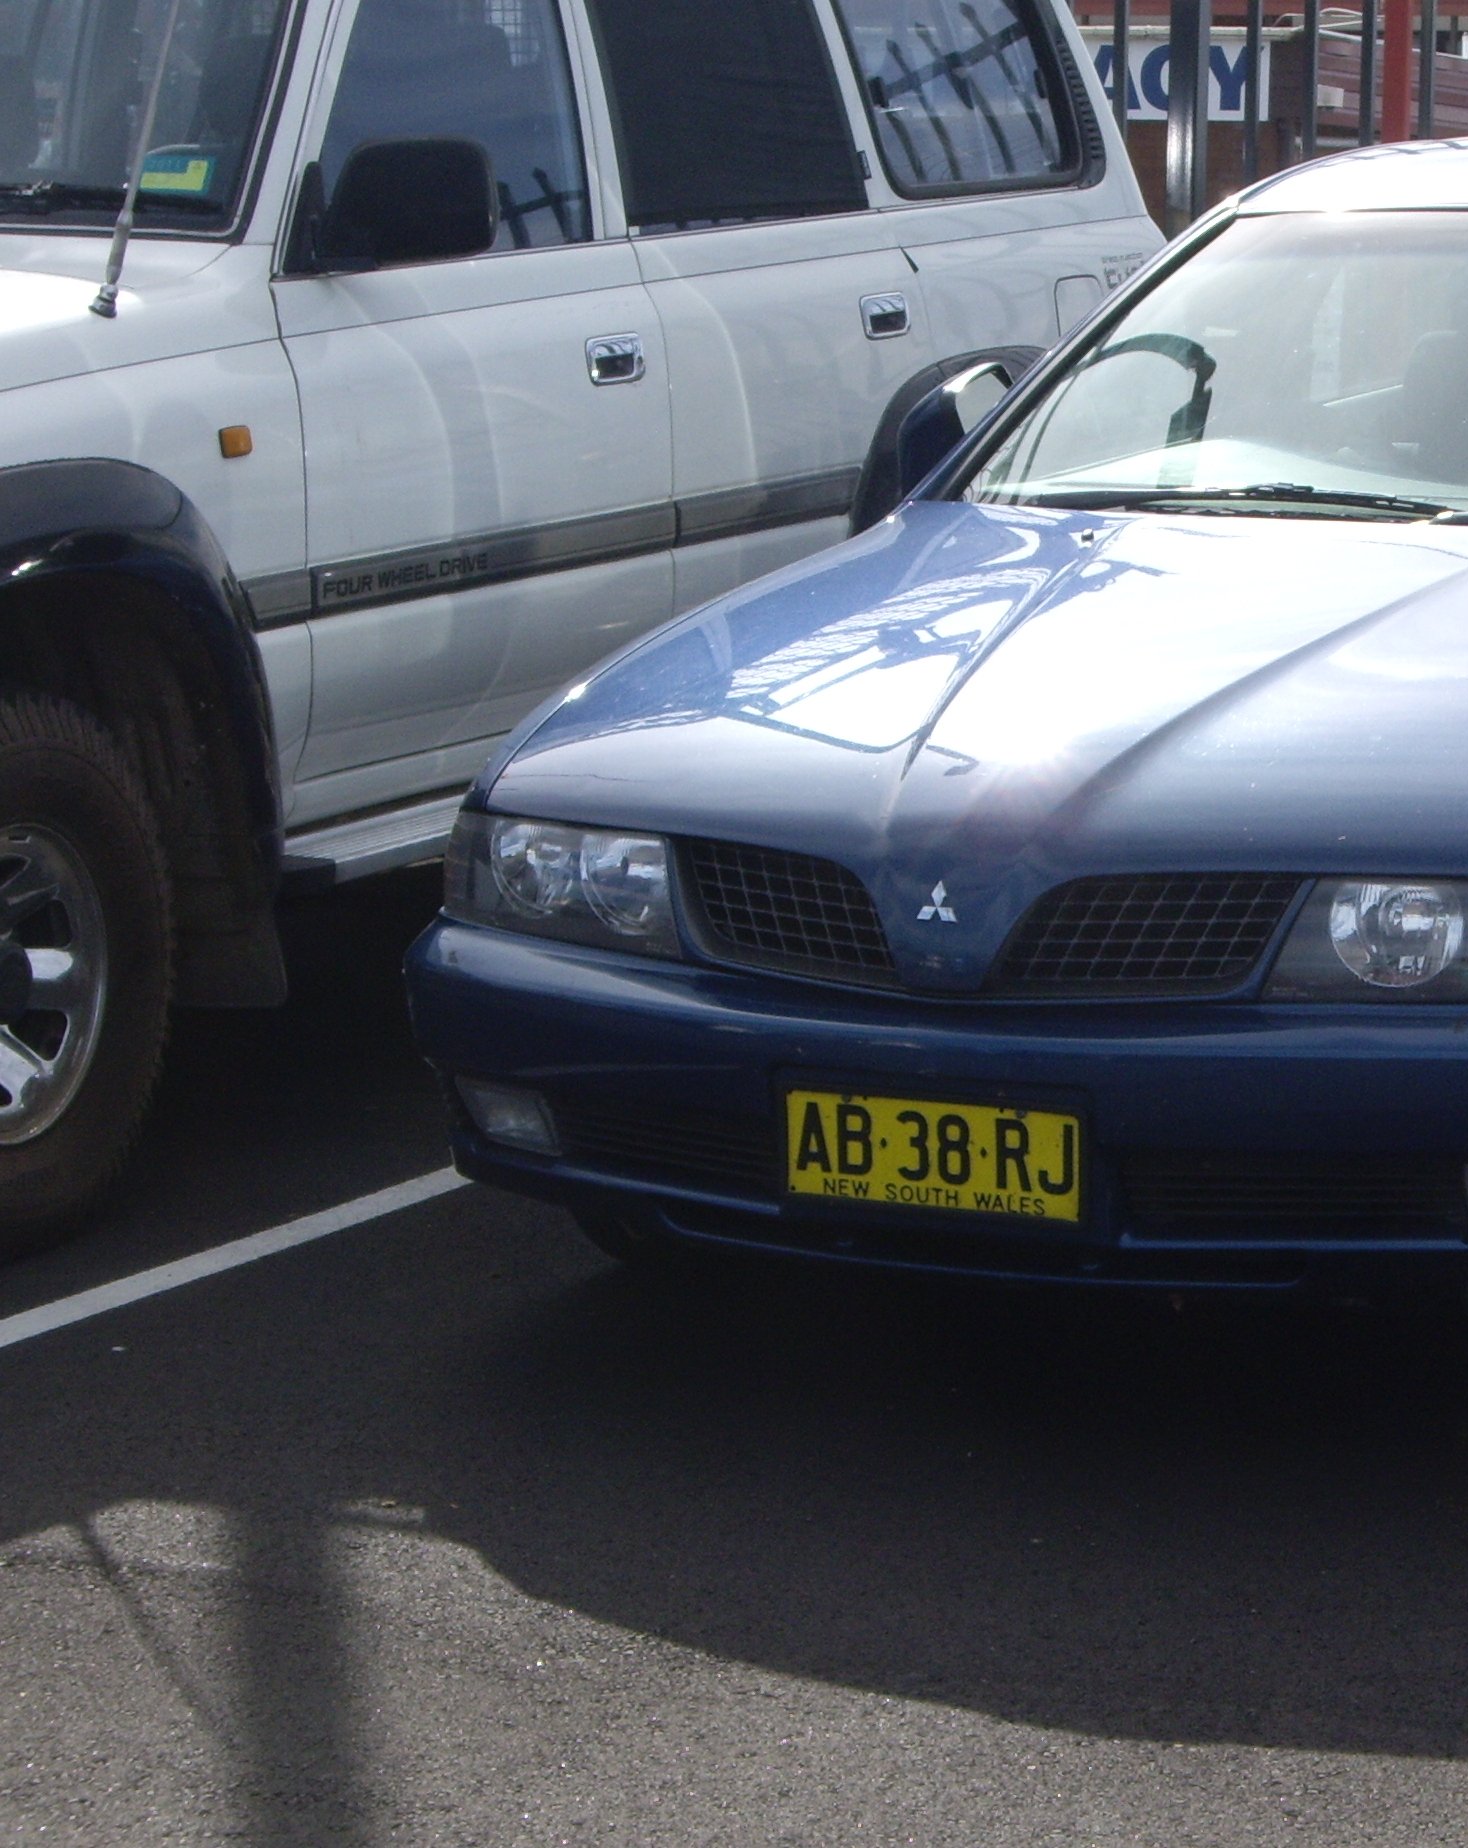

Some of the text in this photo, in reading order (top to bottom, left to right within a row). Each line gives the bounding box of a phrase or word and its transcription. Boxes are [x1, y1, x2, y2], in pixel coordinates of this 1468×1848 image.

[322, 553, 489, 598] FOUR WHEEL DRIVE
[823, 1178, 1046, 1216] NEW SOUTH WALES
